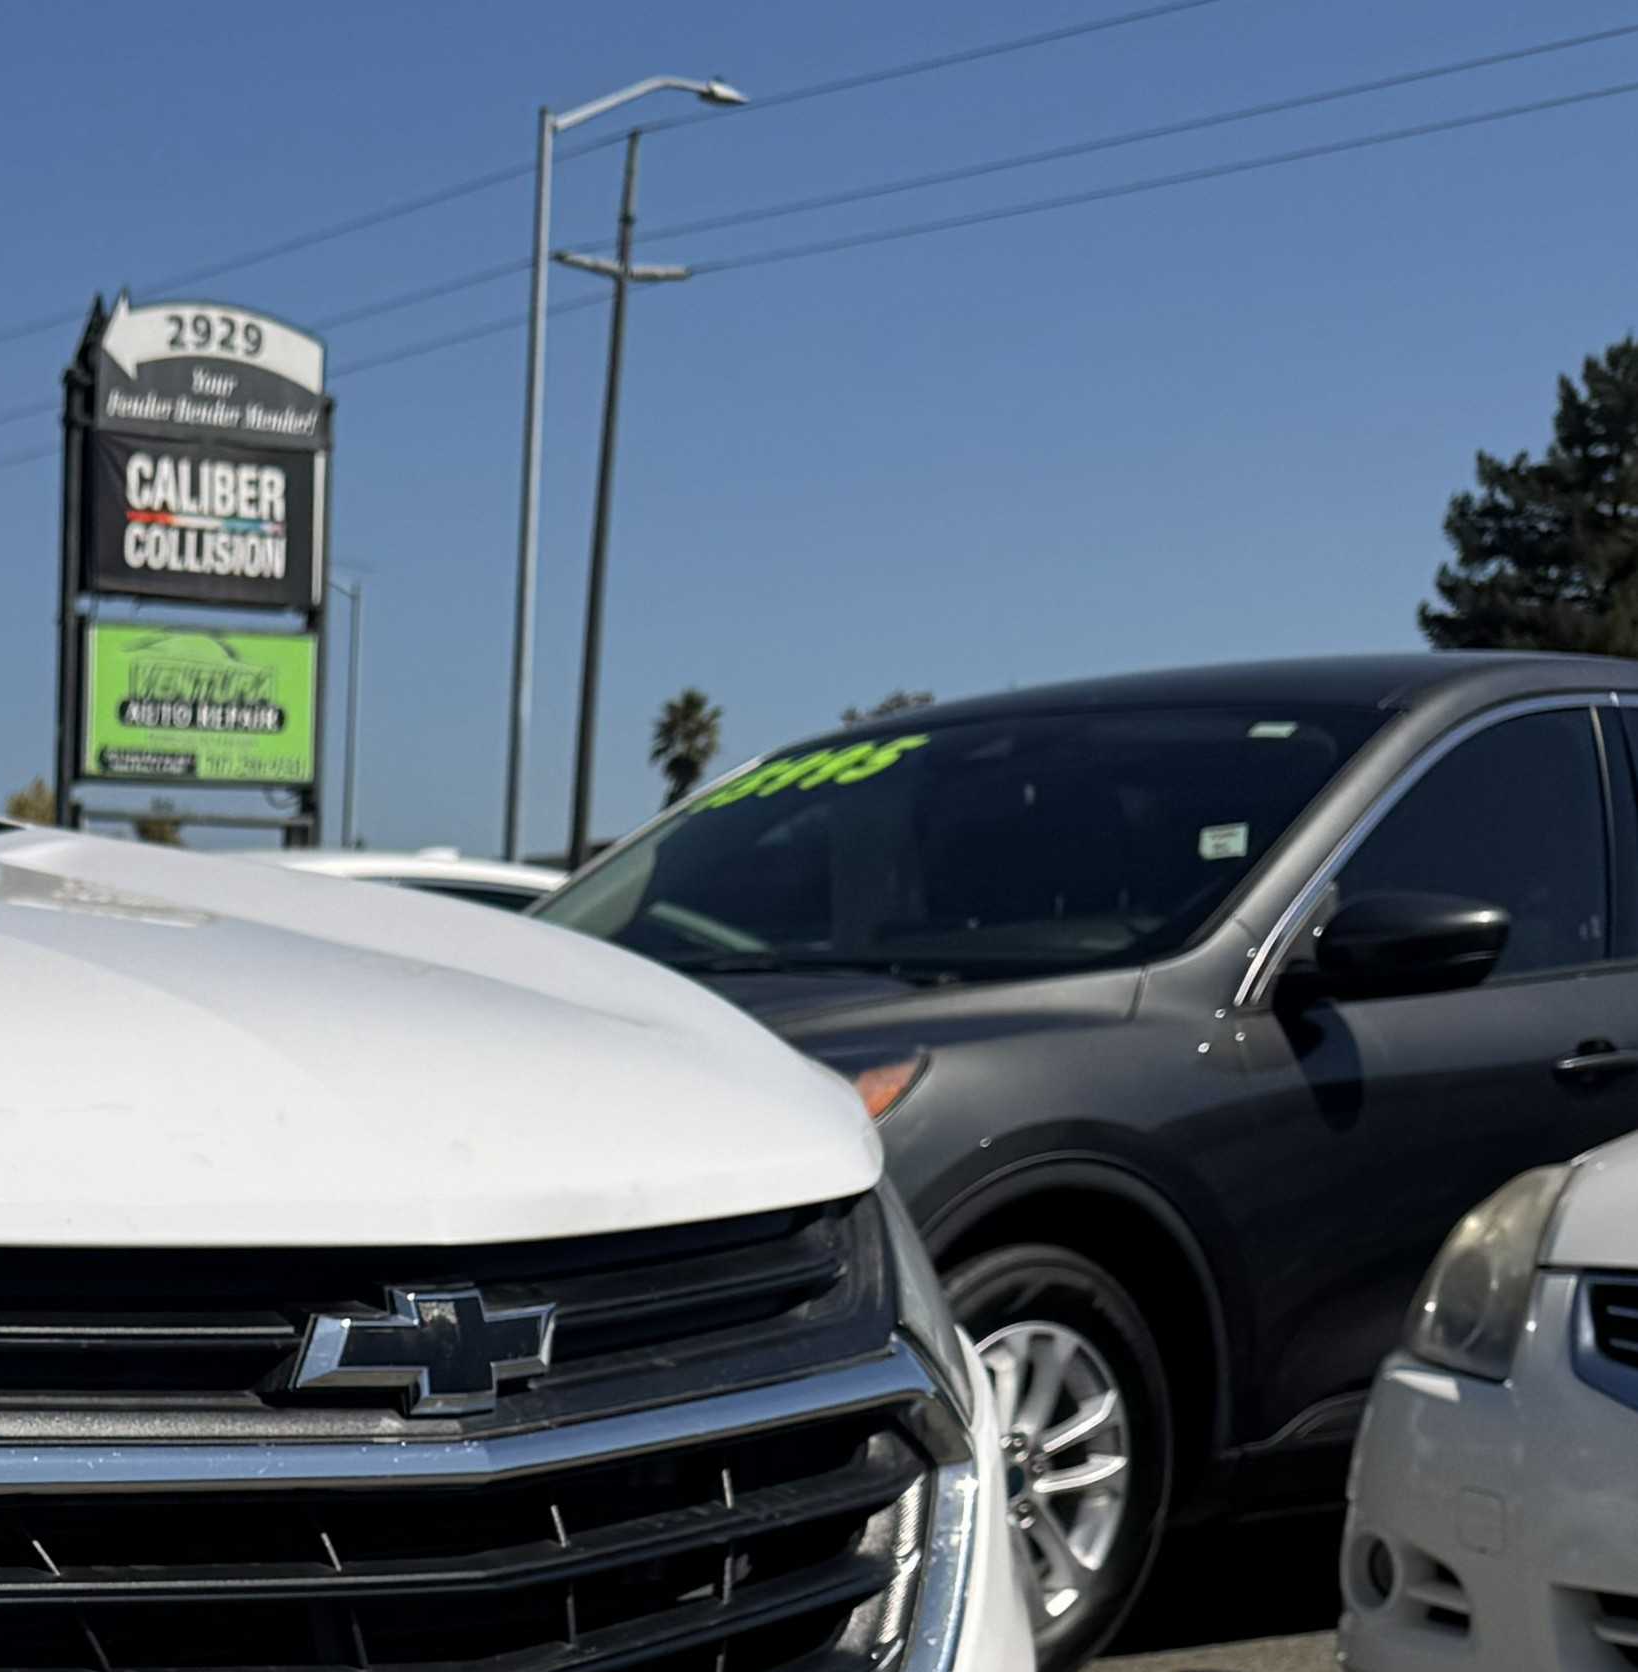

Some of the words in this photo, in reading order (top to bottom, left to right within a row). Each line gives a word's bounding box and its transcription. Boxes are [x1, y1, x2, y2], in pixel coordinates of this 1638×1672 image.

[167, 314, 263, 356] 2929
[126, 453, 286, 521] CALIBER
[124, 522, 287, 579] COLLISION
[126, 699, 192, 728] AUTO
[196, 702, 279, 731] REPAIR
